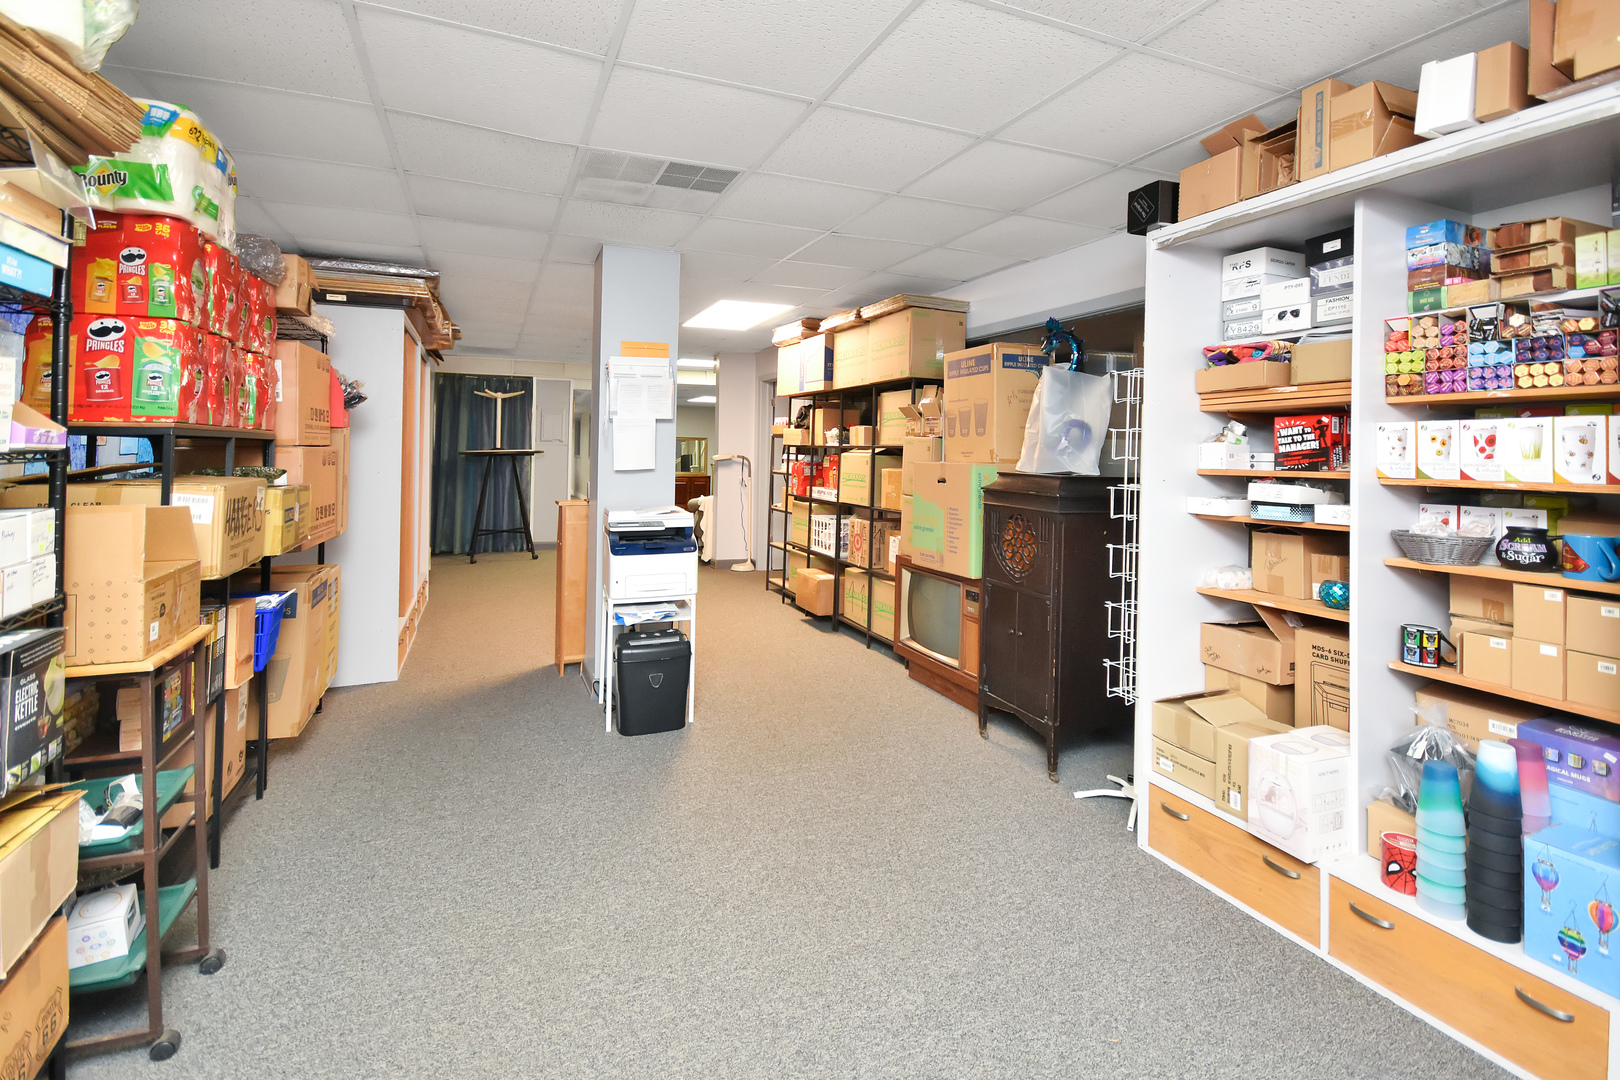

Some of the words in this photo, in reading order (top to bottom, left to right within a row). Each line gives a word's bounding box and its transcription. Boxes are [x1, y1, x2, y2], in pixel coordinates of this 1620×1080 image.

[80, 169, 128, 188] Bounty
[155, 222, 170, 232] 36
[118, 263, 146, 276] PRINGLES
[1324, 272, 1350, 284] FENDI
[160, 320, 176, 332] 36
[86, 338, 124, 353] PRINGLES
[960, 359, 976, 368] ULINE
[960, 367, 979, 375] INSULATED
[1280, 426, 1303, 436] WANT
[1278, 436, 1292, 444] TALK
[1279, 441, 1320, 453] MANAGER!
[1507, 550, 1545, 564] Sugar
[1312, 644, 1332, 654] MDS-6
[1312, 652, 1329, 661] CARD
[20, 673, 36, 686] GLASS
[15, 680, 39, 704] ELECTRIC
[14, 694, 38, 722] KETTLE
[1547, 765, 1569, 776] AGICAL
[1570, 773, 1591, 783] MUGS
